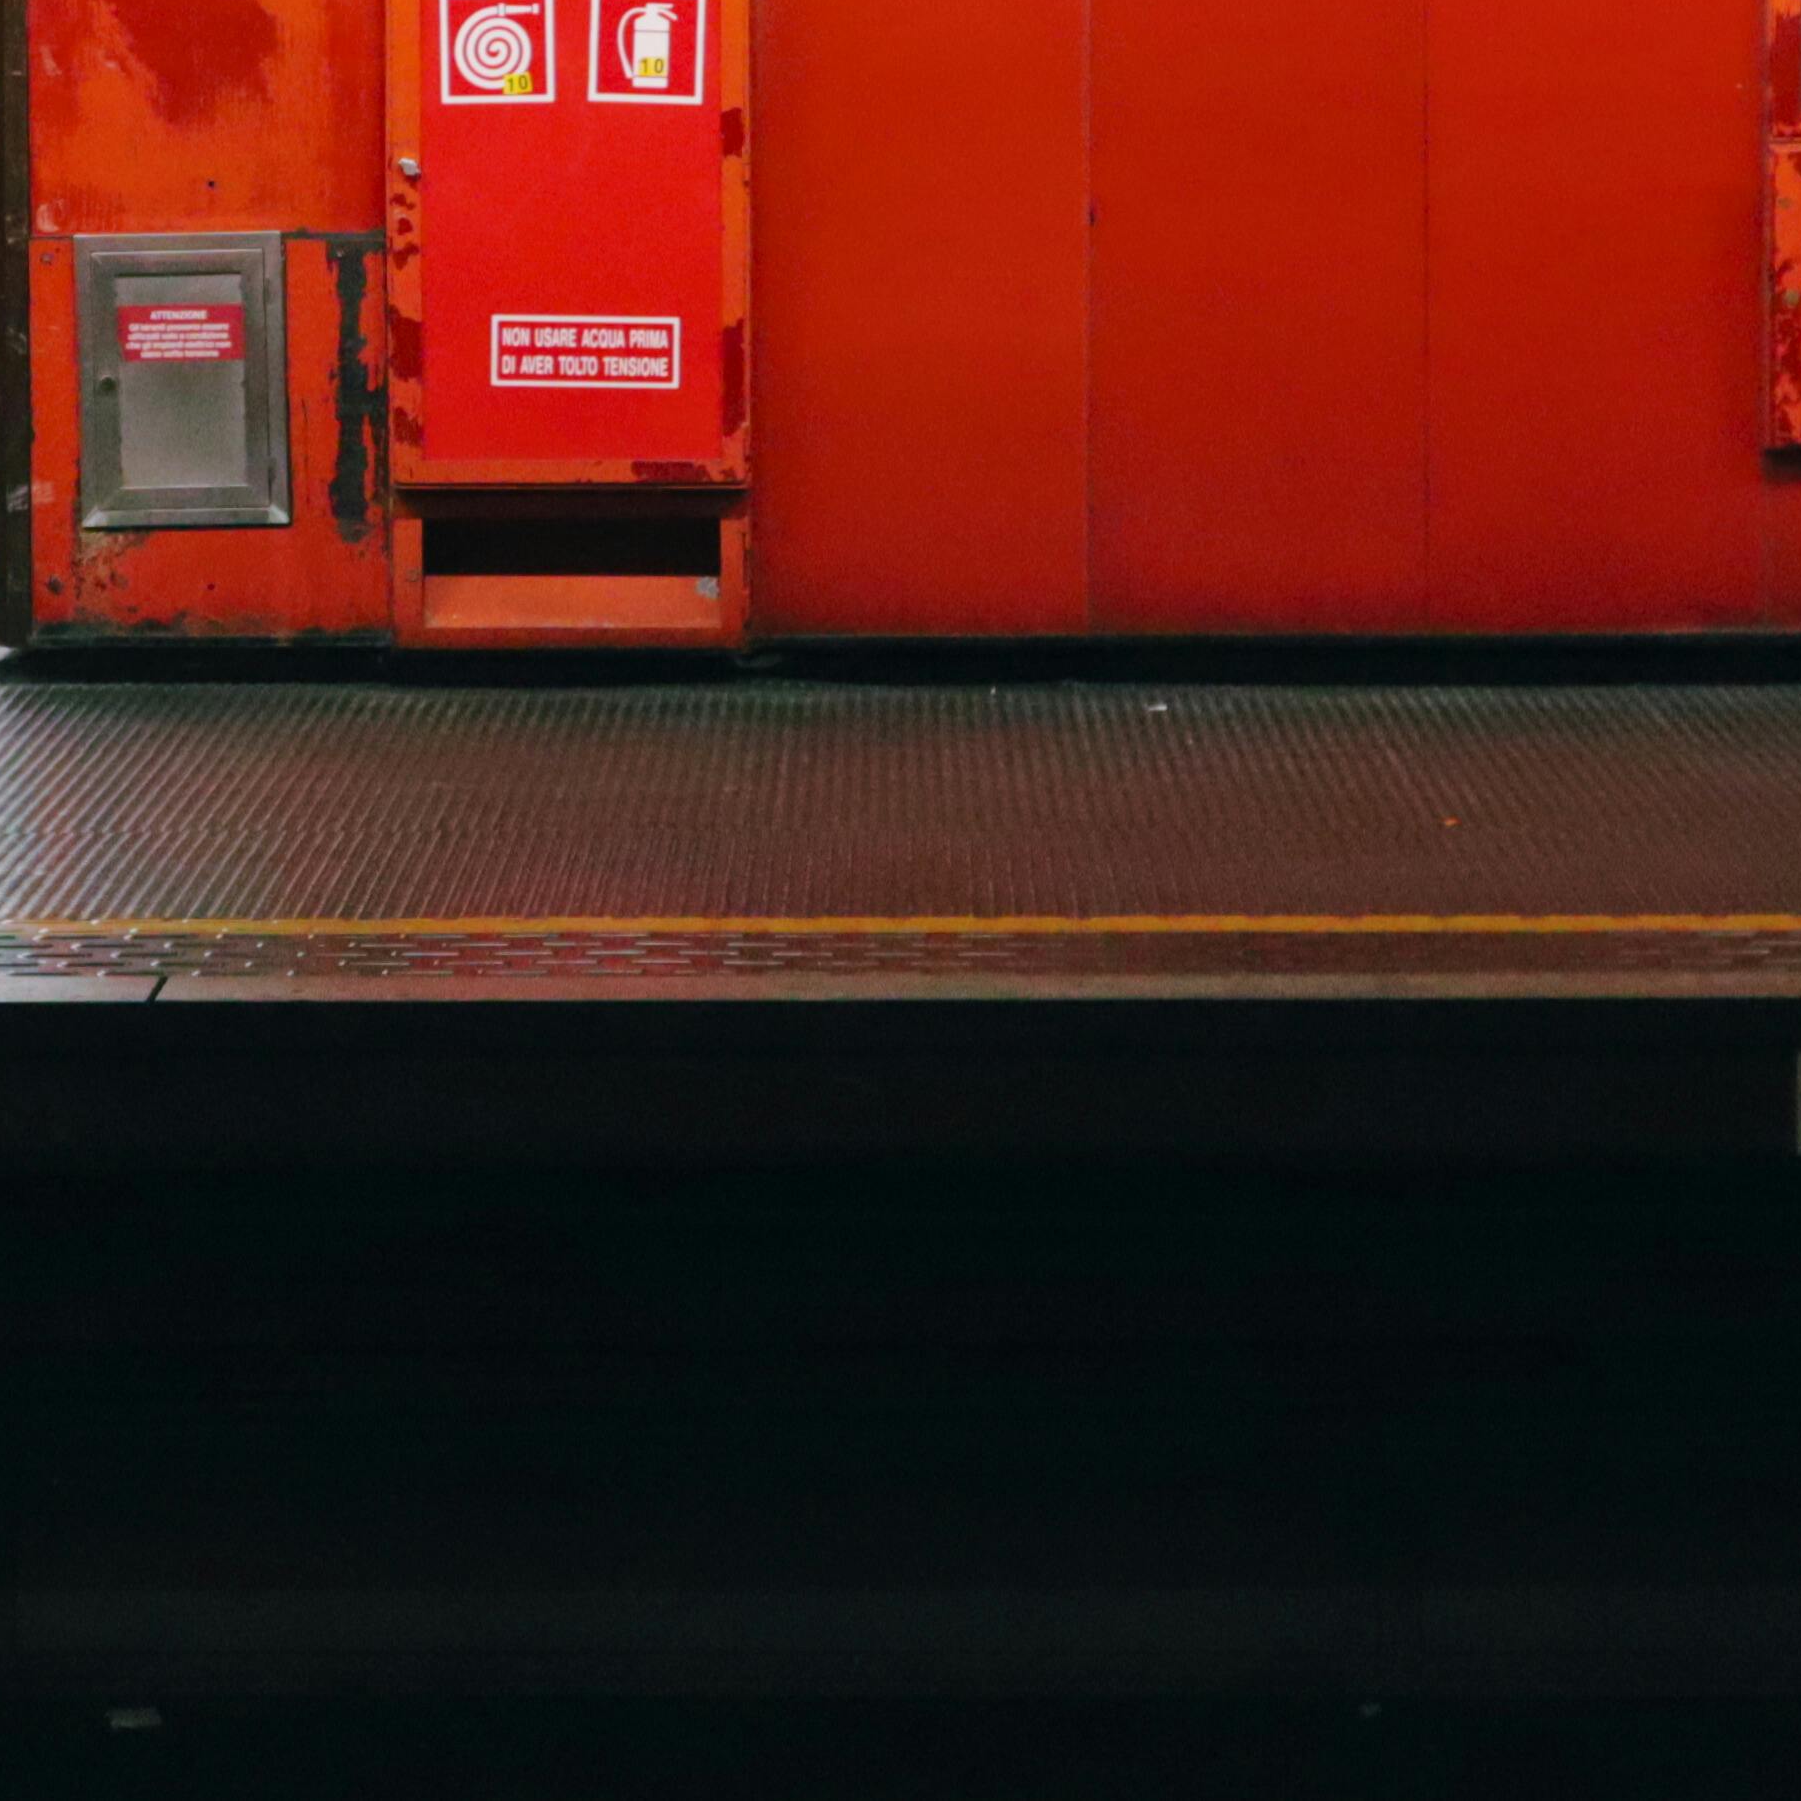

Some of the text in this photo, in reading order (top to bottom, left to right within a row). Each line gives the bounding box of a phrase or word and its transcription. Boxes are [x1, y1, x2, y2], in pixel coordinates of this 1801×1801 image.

[502, 327, 669, 349] NON USARE ACQUA PRIMA
[501, 355, 669, 377] DI AVER TOLTO TENSIONE
